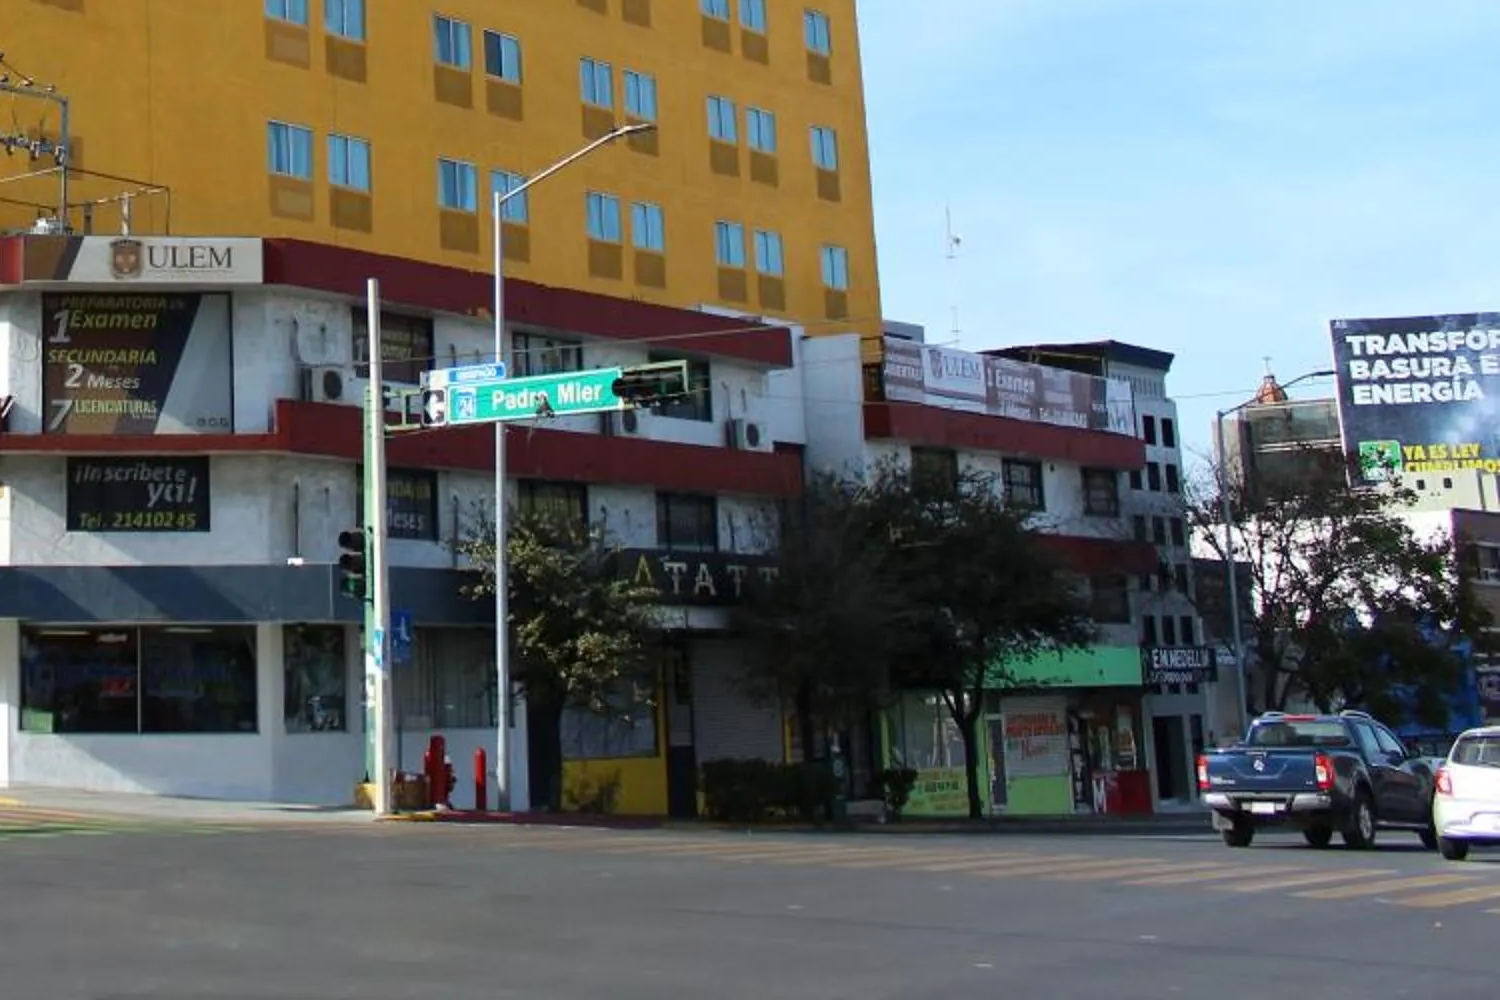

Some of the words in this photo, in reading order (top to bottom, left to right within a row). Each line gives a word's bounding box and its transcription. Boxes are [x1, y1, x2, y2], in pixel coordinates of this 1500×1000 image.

[148, 245, 233, 269] ULEM
[49, 310, 71, 343] 1
[70, 310, 158, 329] Examen
[48, 350, 157, 365] SECUNDARIA
[1350, 356, 1473, 379] BASURA
[64, 364, 84, 388] 2
[87, 375, 140, 389] Meses
[558, 383, 602, 405] Mier
[1354, 376, 1484, 405] ENERGÍA
[50, 400, 73, 430] 7
[1403, 445, 1426, 460] YA
[1452, 443, 1479, 458] LEY
[147, 474, 197, 507] ya!
[112, 511, 197, 528] 21410245
